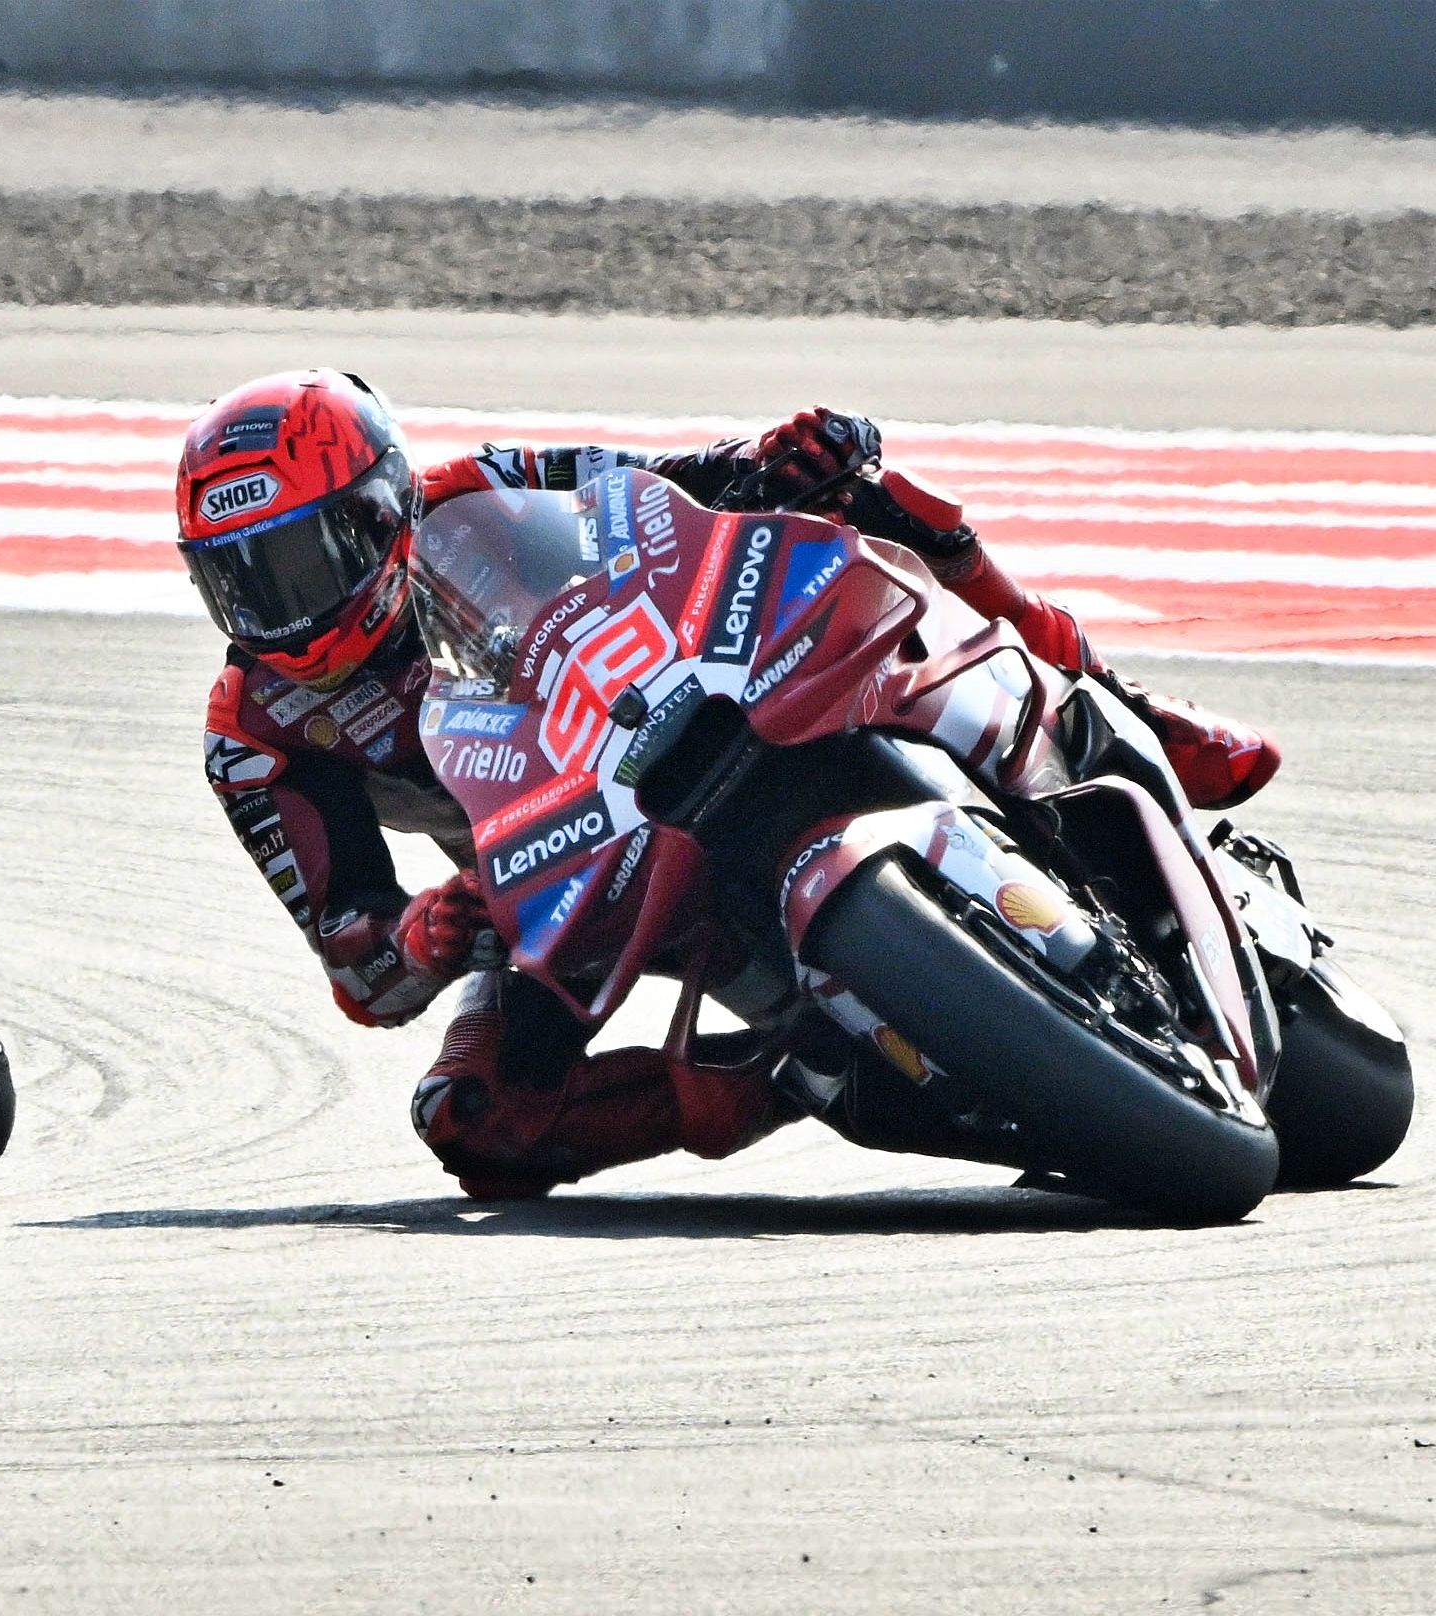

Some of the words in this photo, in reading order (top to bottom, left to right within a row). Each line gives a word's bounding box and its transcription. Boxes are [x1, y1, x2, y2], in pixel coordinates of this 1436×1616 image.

[225, 421, 274, 435] Lenovo
[207, 477, 268, 516] SHOEI
[607, 473, 631, 540] ADVANCE
[635, 479, 678, 557] riello
[713, 526, 772, 655] Lenovo
[803, 555, 844, 597] TIM
[539, 593, 676, 774] 93
[743, 635, 814, 703] CARRERA
[629, 681, 699, 759] MONSTER
[453, 740, 528, 783] riello
[492, 811, 604, 886] Lenovo
[607, 826, 652, 902] CARRERA
[779, 831, 845, 922] enovo
[549, 876, 585, 923] TIM
